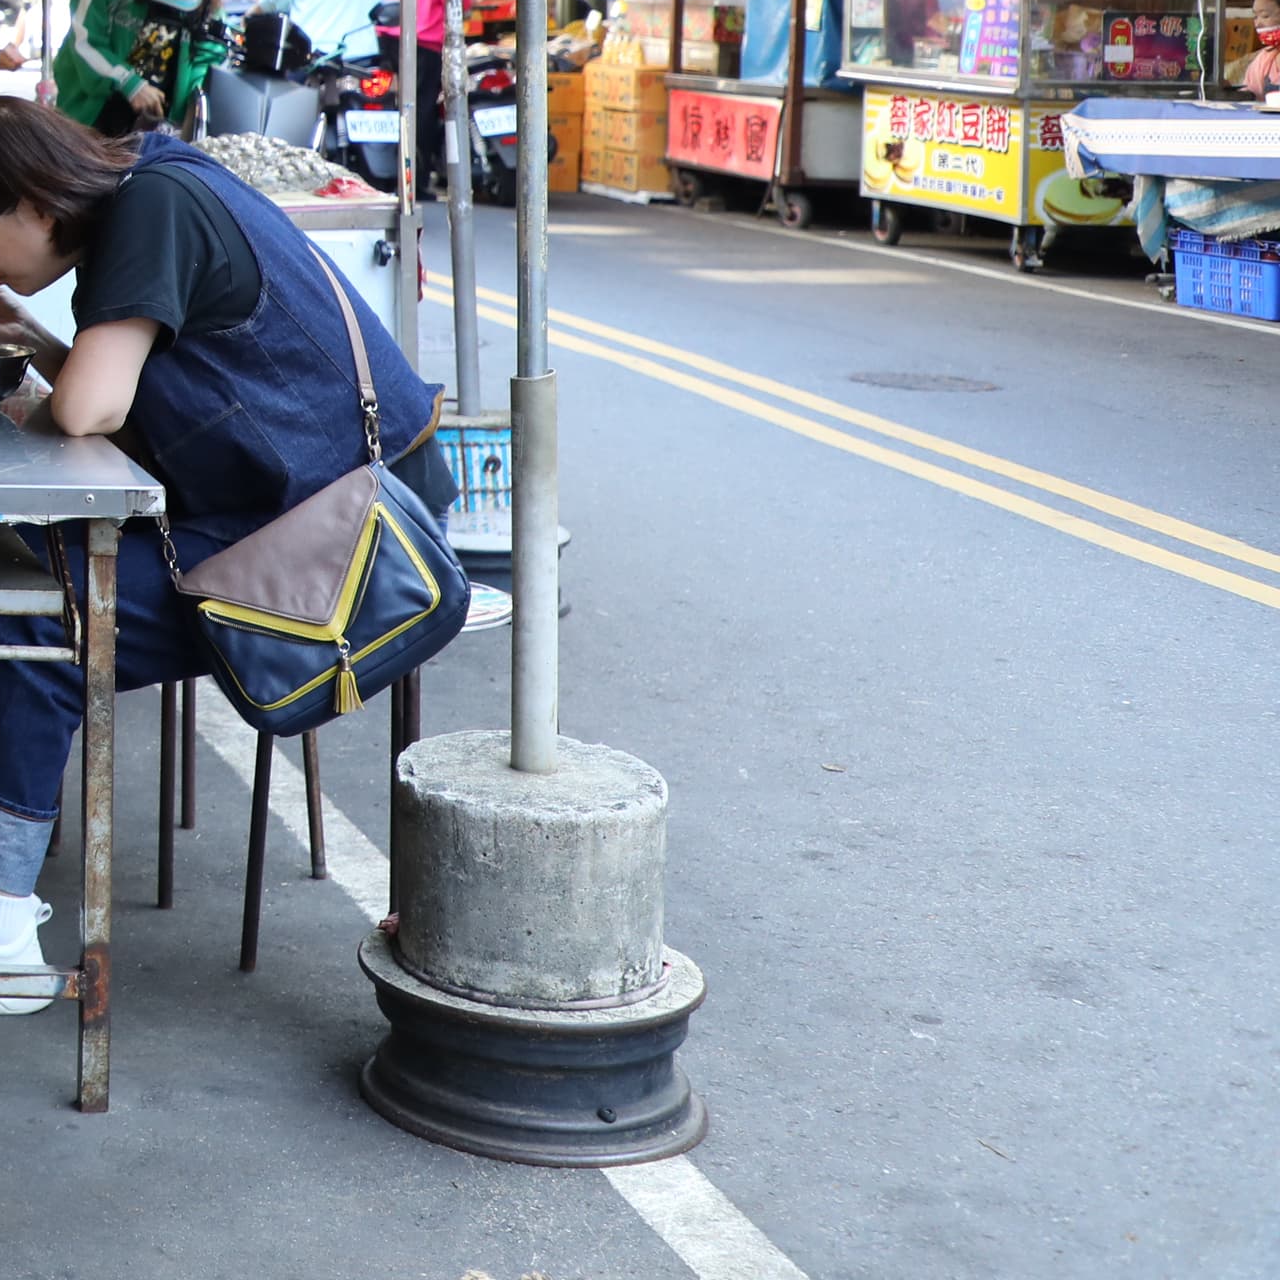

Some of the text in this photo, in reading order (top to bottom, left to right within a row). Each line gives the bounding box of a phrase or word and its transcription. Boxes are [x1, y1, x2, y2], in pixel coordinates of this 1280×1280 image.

[890, 95, 1010, 151] 蔡家紅豆餅
